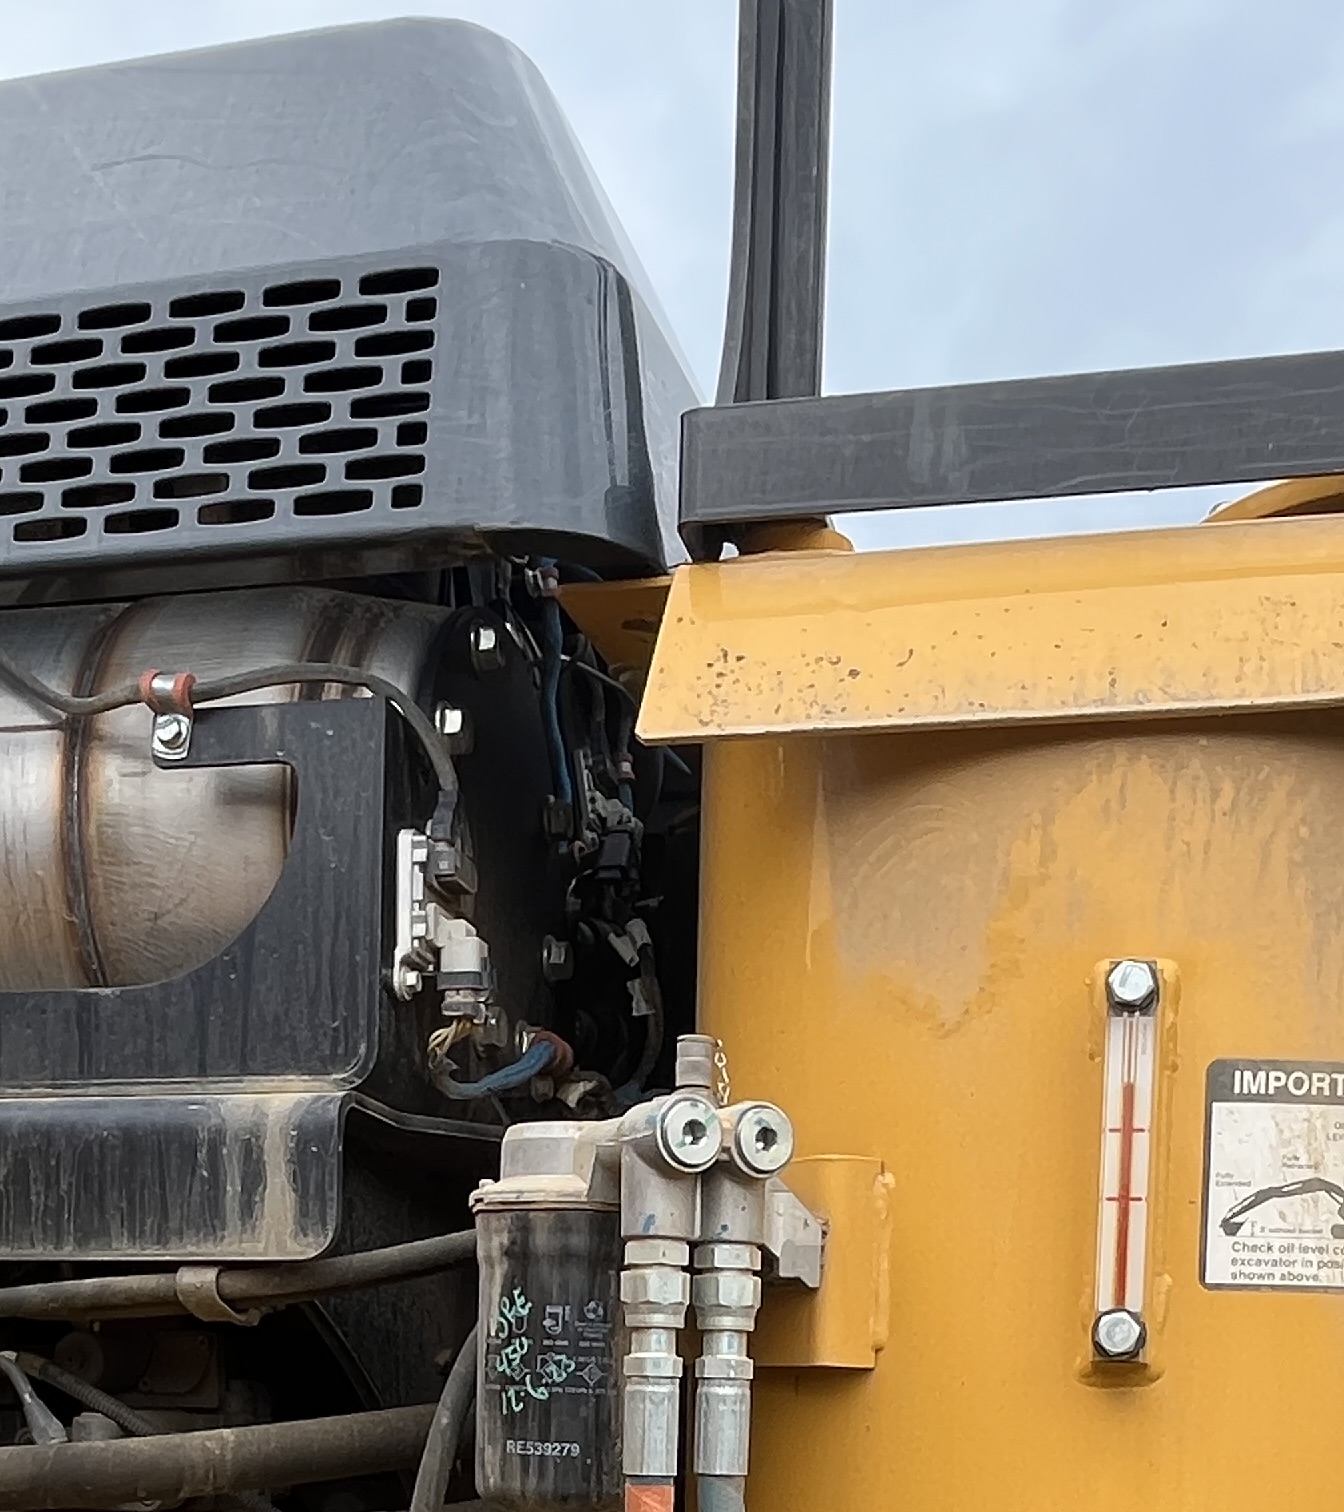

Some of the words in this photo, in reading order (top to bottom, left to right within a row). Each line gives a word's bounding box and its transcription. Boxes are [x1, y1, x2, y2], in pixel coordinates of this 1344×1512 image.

[1231, 1240, 1275, 1254] Check
[1278, 1242, 1296, 1255] oil
[1298, 1242, 1330, 1255] level
[1231, 1256, 1298, 1268] excavator
[1301, 1257, 1314, 1268] in
[1230, 1270, 1276, 1281] shown
[1279, 1270, 1322, 1282] above.
[506, 1440, 580, 1457] RE539279
